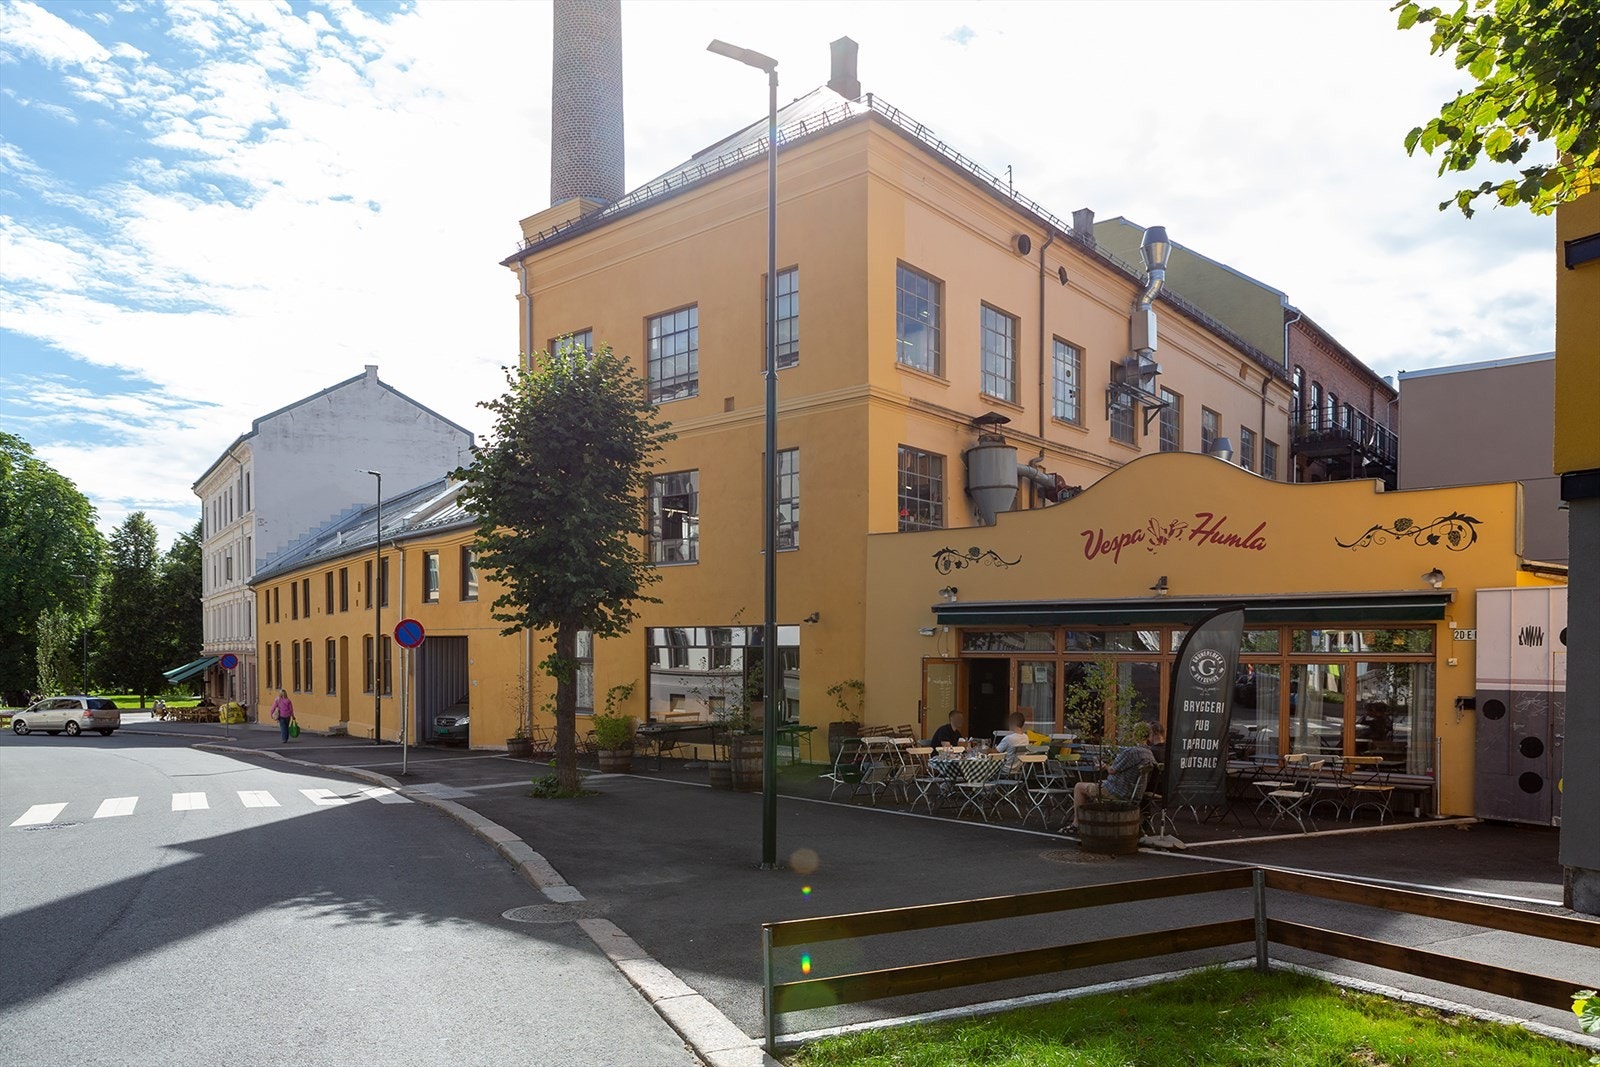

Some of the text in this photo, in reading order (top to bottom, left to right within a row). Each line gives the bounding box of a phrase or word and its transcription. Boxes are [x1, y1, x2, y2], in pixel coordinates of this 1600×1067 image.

[1080, 512, 1267, 564] Vespa Humla
[1454, 630, 1465, 640] 20
[1198, 658, 1216, 676] G
[1183, 700, 1225, 713] BRYGGERI
[1194, 719, 1210, 731] PUB
[1182, 738, 1219, 750] TAPROOM
